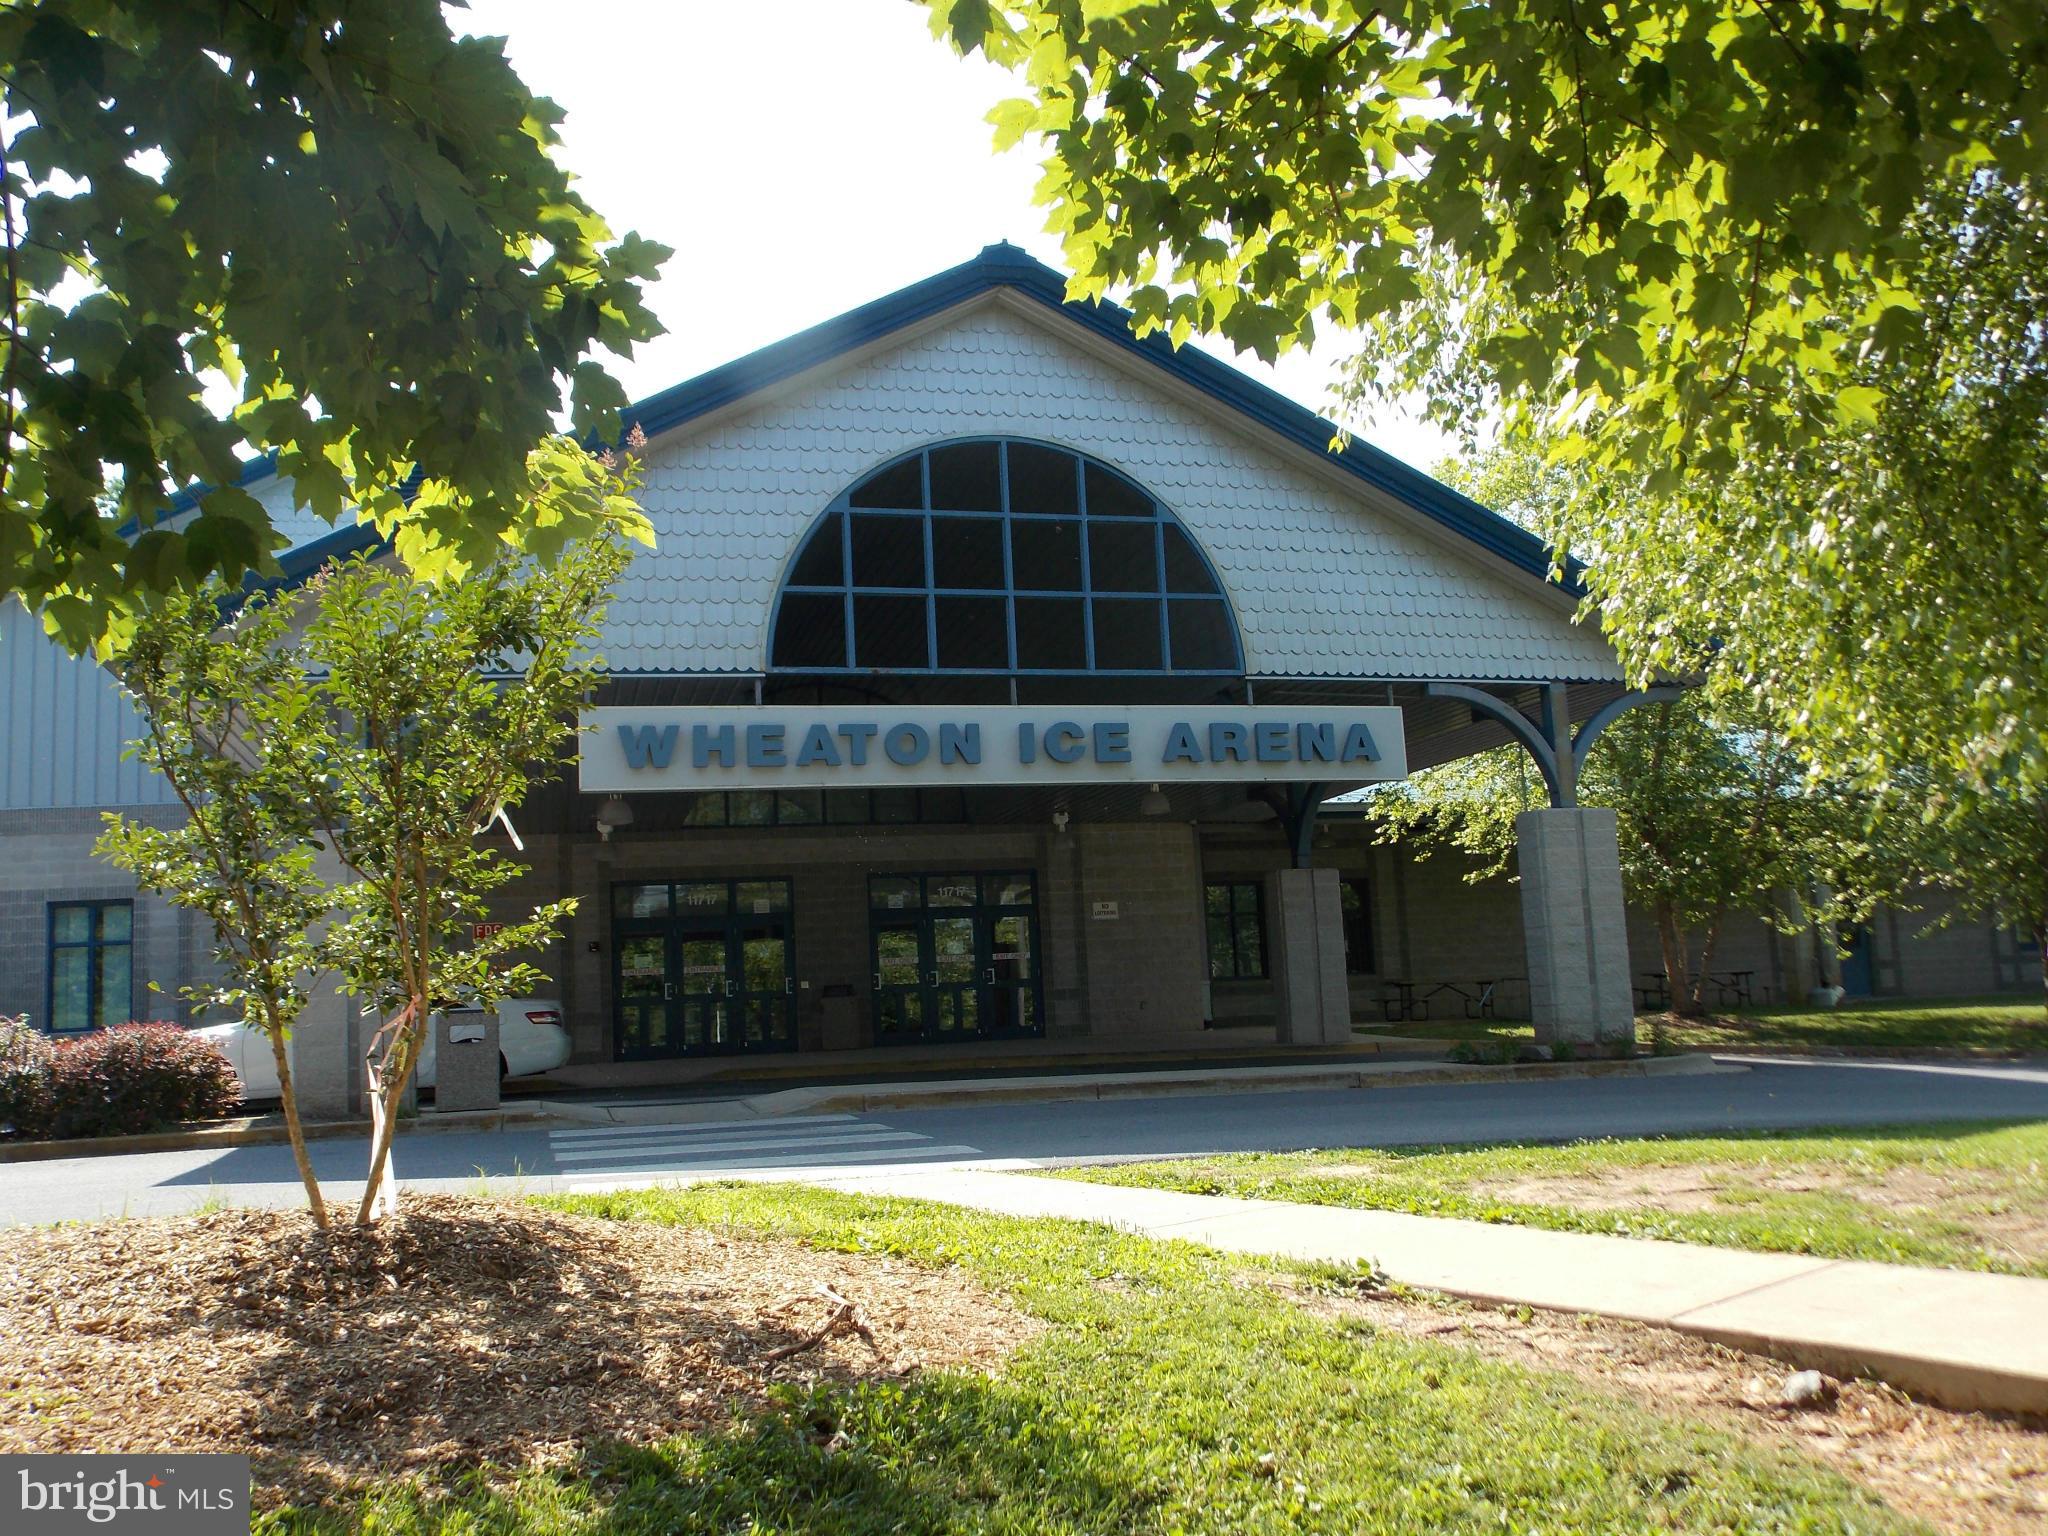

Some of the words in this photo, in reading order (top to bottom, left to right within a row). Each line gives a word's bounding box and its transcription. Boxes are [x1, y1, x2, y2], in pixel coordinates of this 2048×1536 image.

[617, 722, 982, 769] WHEATON
[1018, 721, 1132, 764] ICE
[1161, 722, 1382, 763] ARENA
[937, 887, 966, 897] 11717
[686, 895, 717, 906] 11717
